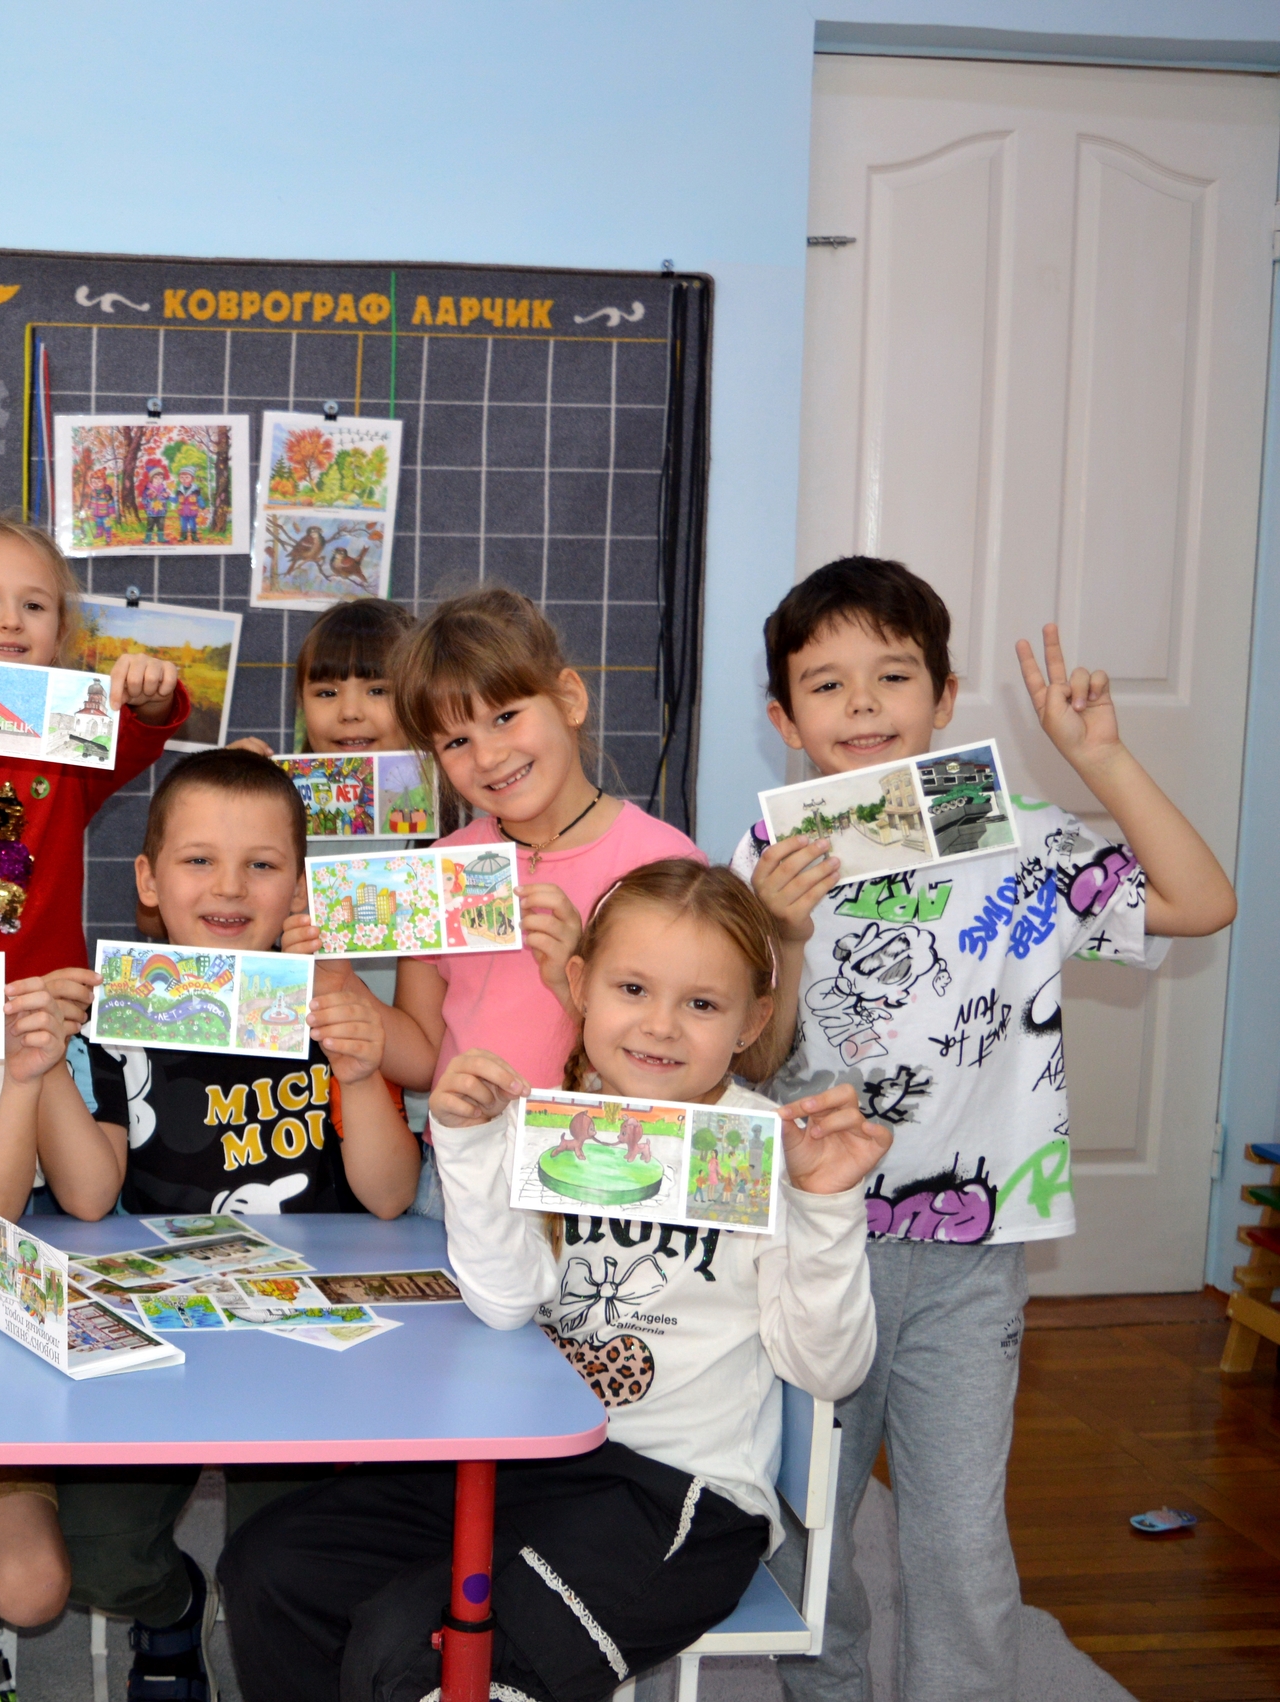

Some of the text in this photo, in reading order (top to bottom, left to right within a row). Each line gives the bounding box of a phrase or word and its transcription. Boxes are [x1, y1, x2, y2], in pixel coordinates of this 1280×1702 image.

[163, 288, 554, 329] КОВРОГРАФ ЛАРЧИК
[336, 784, 360, 803] ЛЕТ
[631, 1311, 678, 1326] Angeles
[5, 1319, 60, 1364] НОВОКУЗНЕЦК
